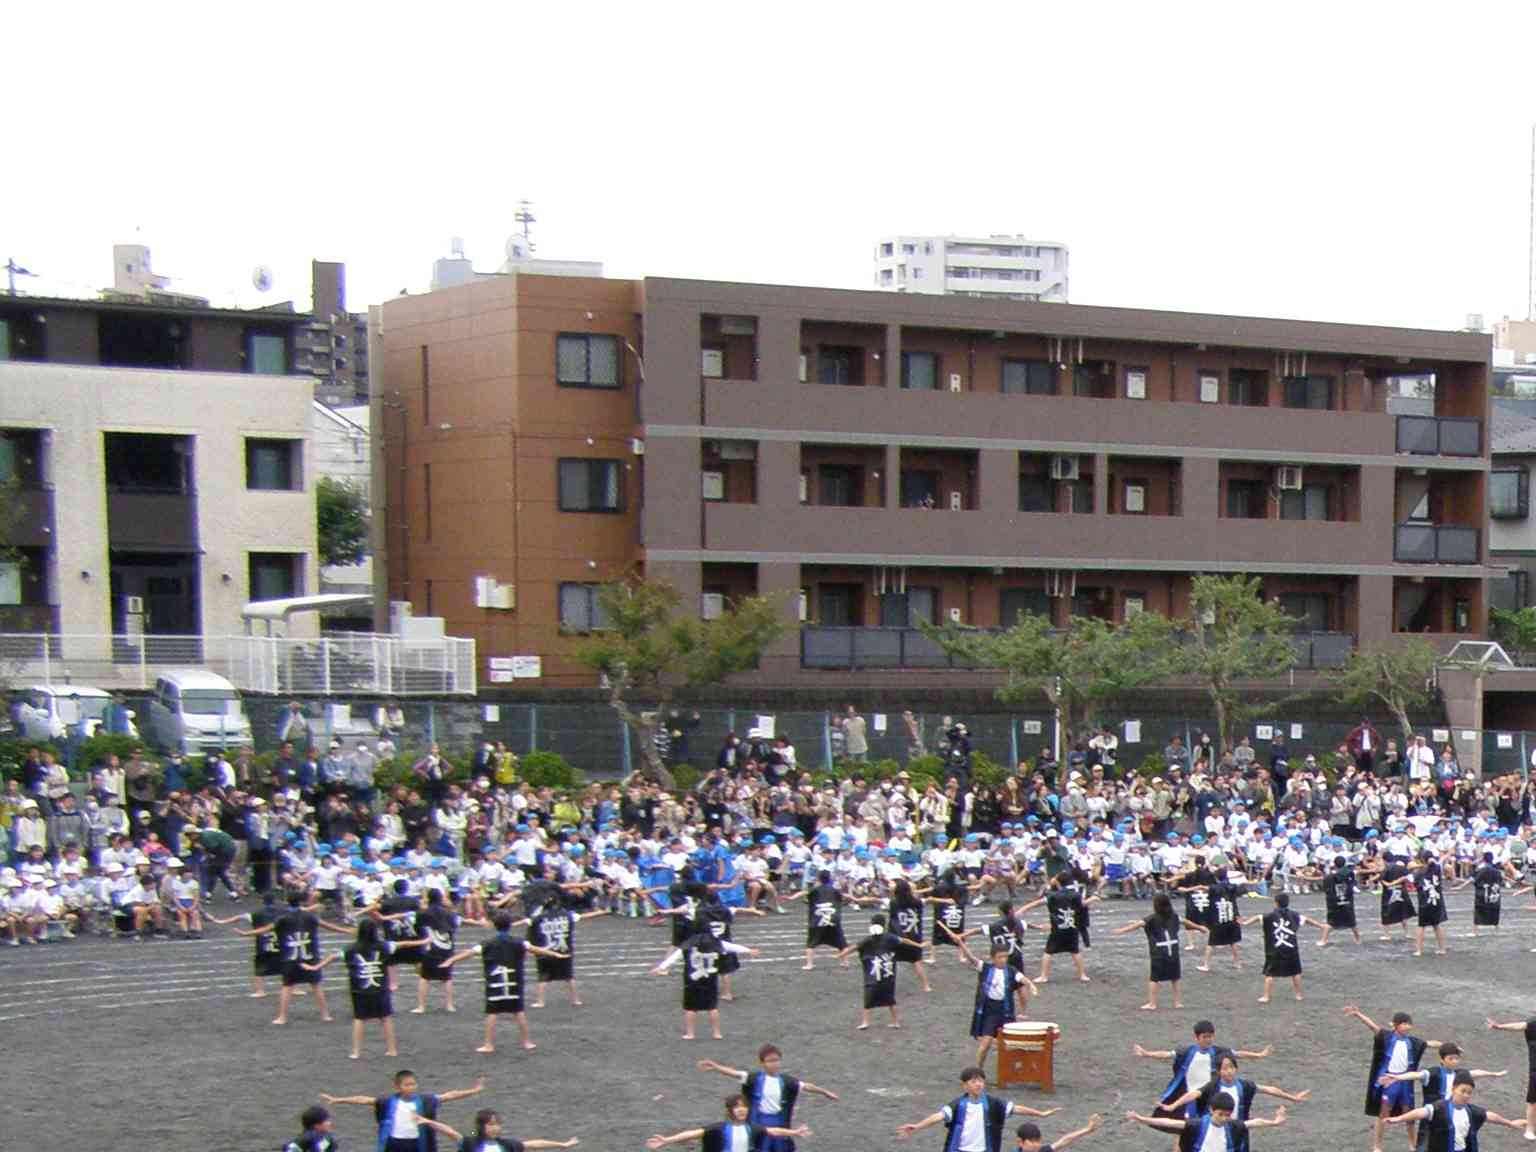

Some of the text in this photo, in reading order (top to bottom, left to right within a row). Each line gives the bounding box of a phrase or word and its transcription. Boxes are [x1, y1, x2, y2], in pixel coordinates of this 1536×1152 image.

[286, 930, 313, 961] 光
[1155, 929, 1179, 957] 十
[1272, 917, 1296, 948] 炎
[355, 950, 385, 990] 美
